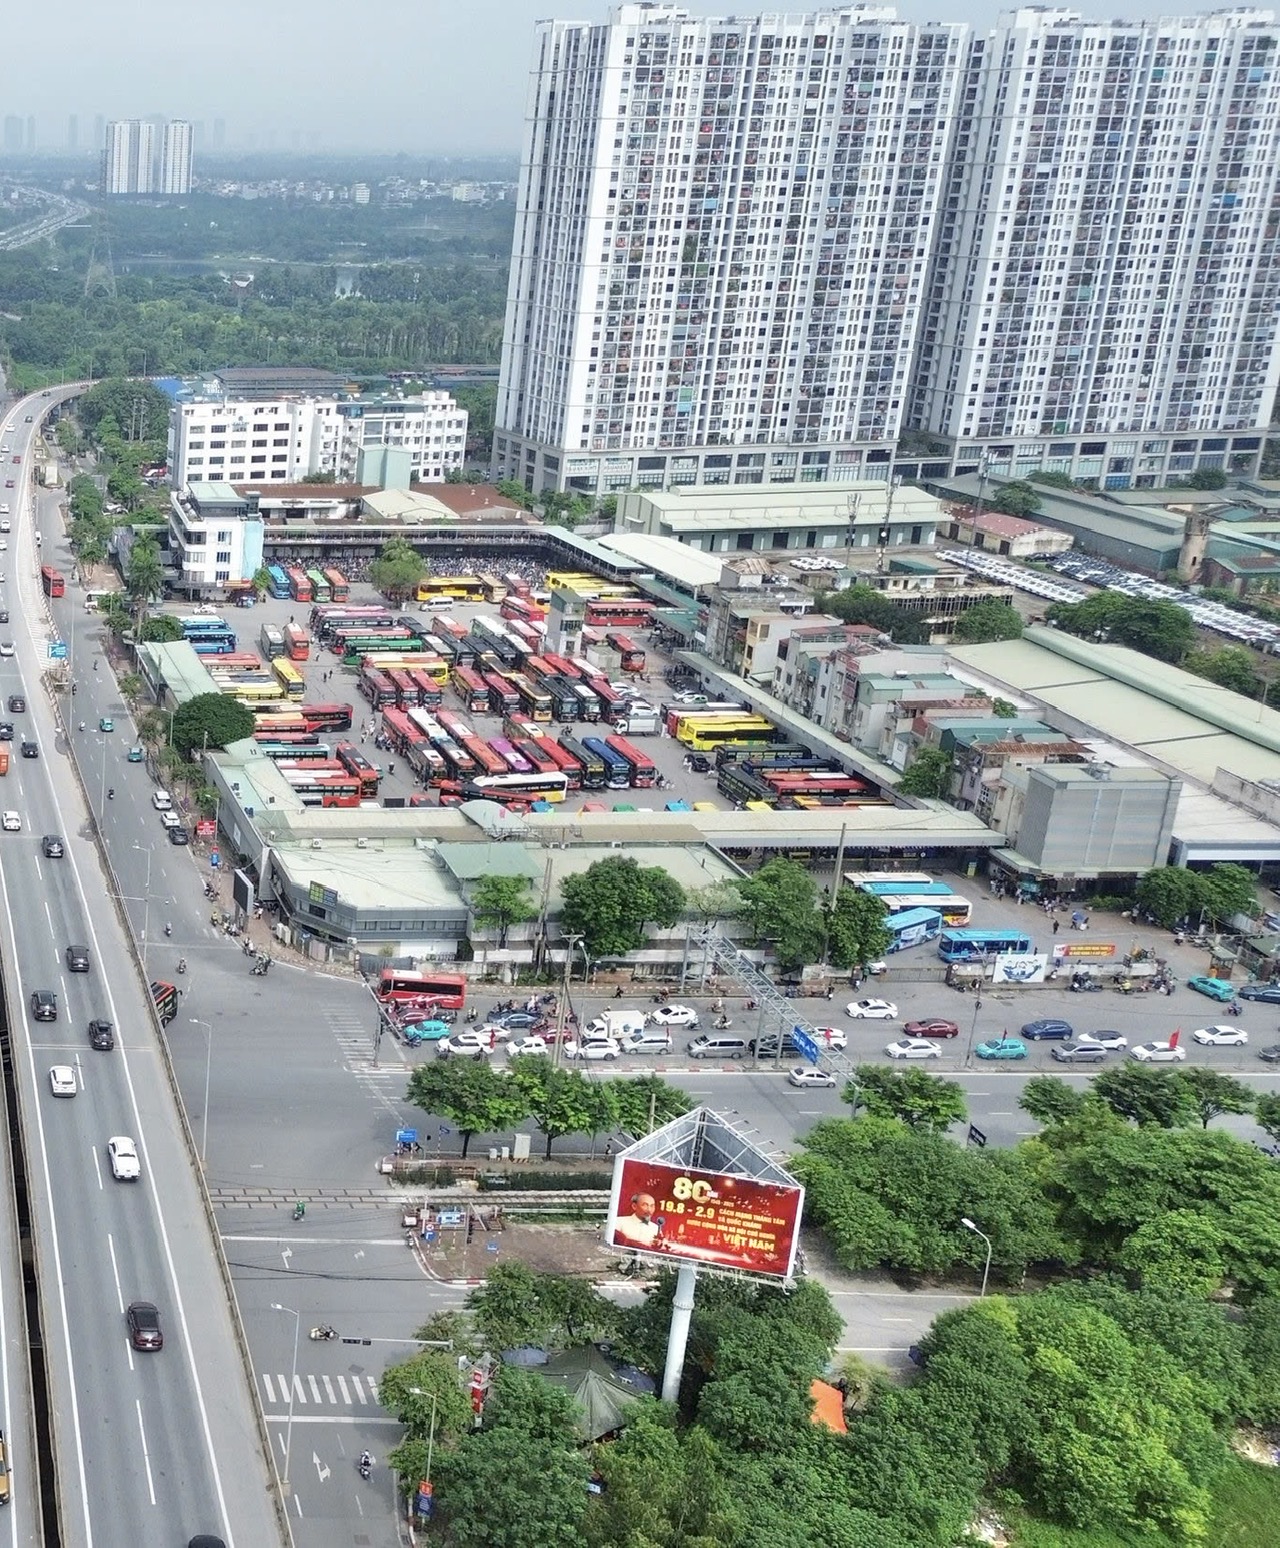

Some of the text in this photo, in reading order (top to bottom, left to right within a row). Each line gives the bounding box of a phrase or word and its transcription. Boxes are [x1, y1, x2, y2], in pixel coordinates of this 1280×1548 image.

[660, 1200, 685, 1214] 19.8
[695, 1206, 715, 1219] 2.9
[723, 1233, 775, 1251] VIỆT NAM
